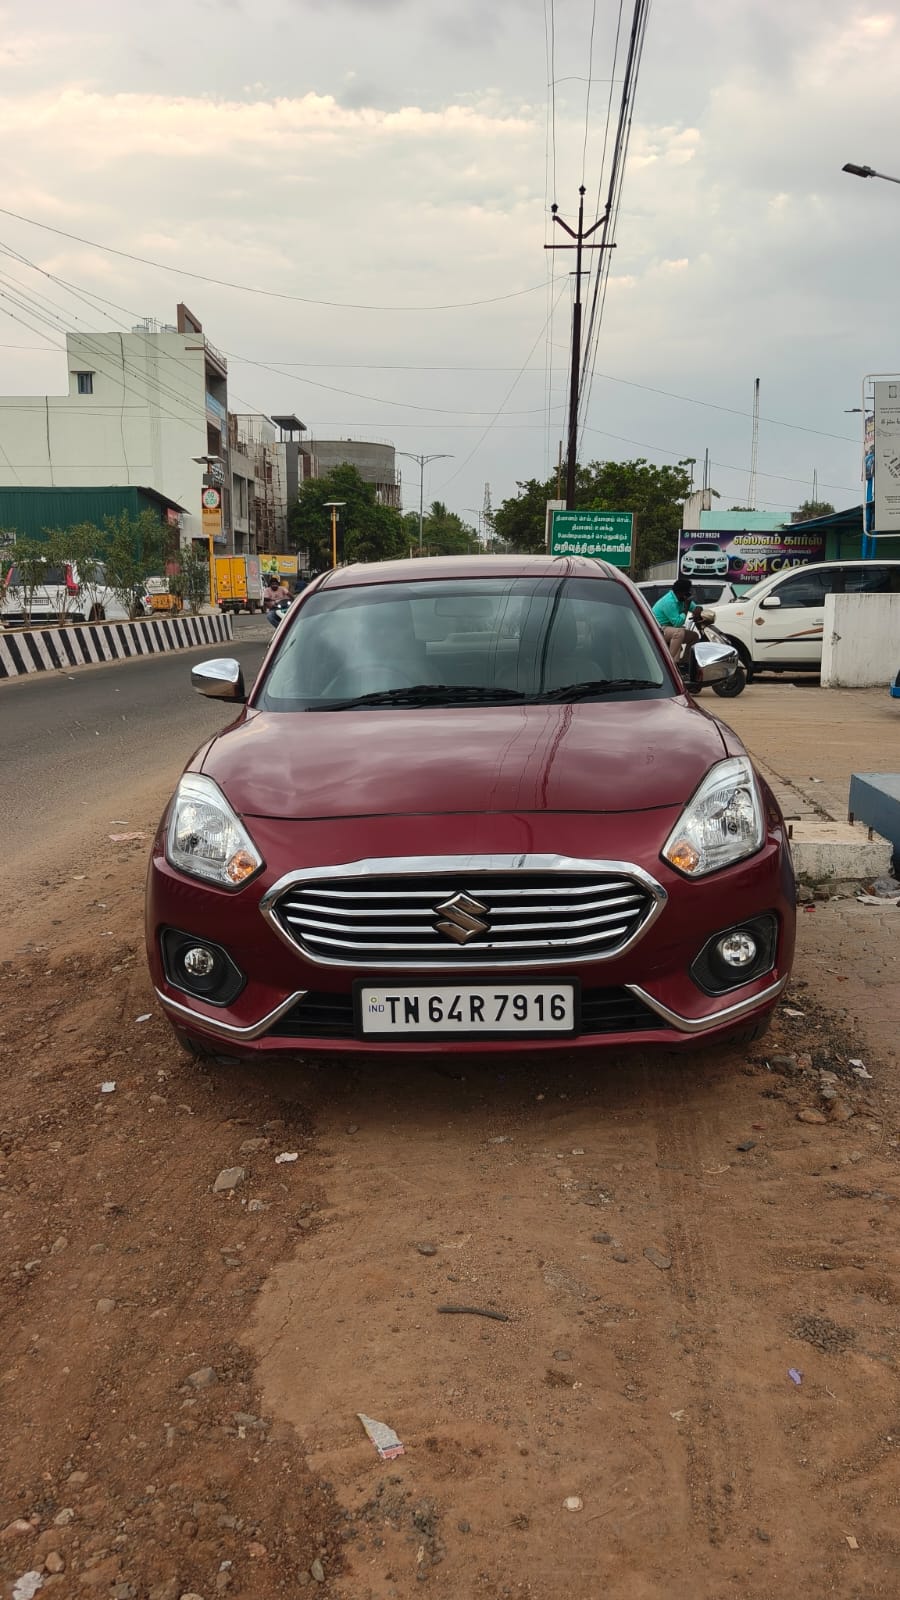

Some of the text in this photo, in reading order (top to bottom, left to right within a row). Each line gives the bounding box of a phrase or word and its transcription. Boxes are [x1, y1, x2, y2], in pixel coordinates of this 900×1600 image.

[783, 533, 823, 546] கார்ஸ்
[554, 541, 632, 554] அறிவுத்திருக்கோயில்
[746, 558, 767, 572] SM
[368, 1004, 385, 1013] IND
[385, 996, 420, 1024] TN
[493, 994, 566, 1022] 7916
